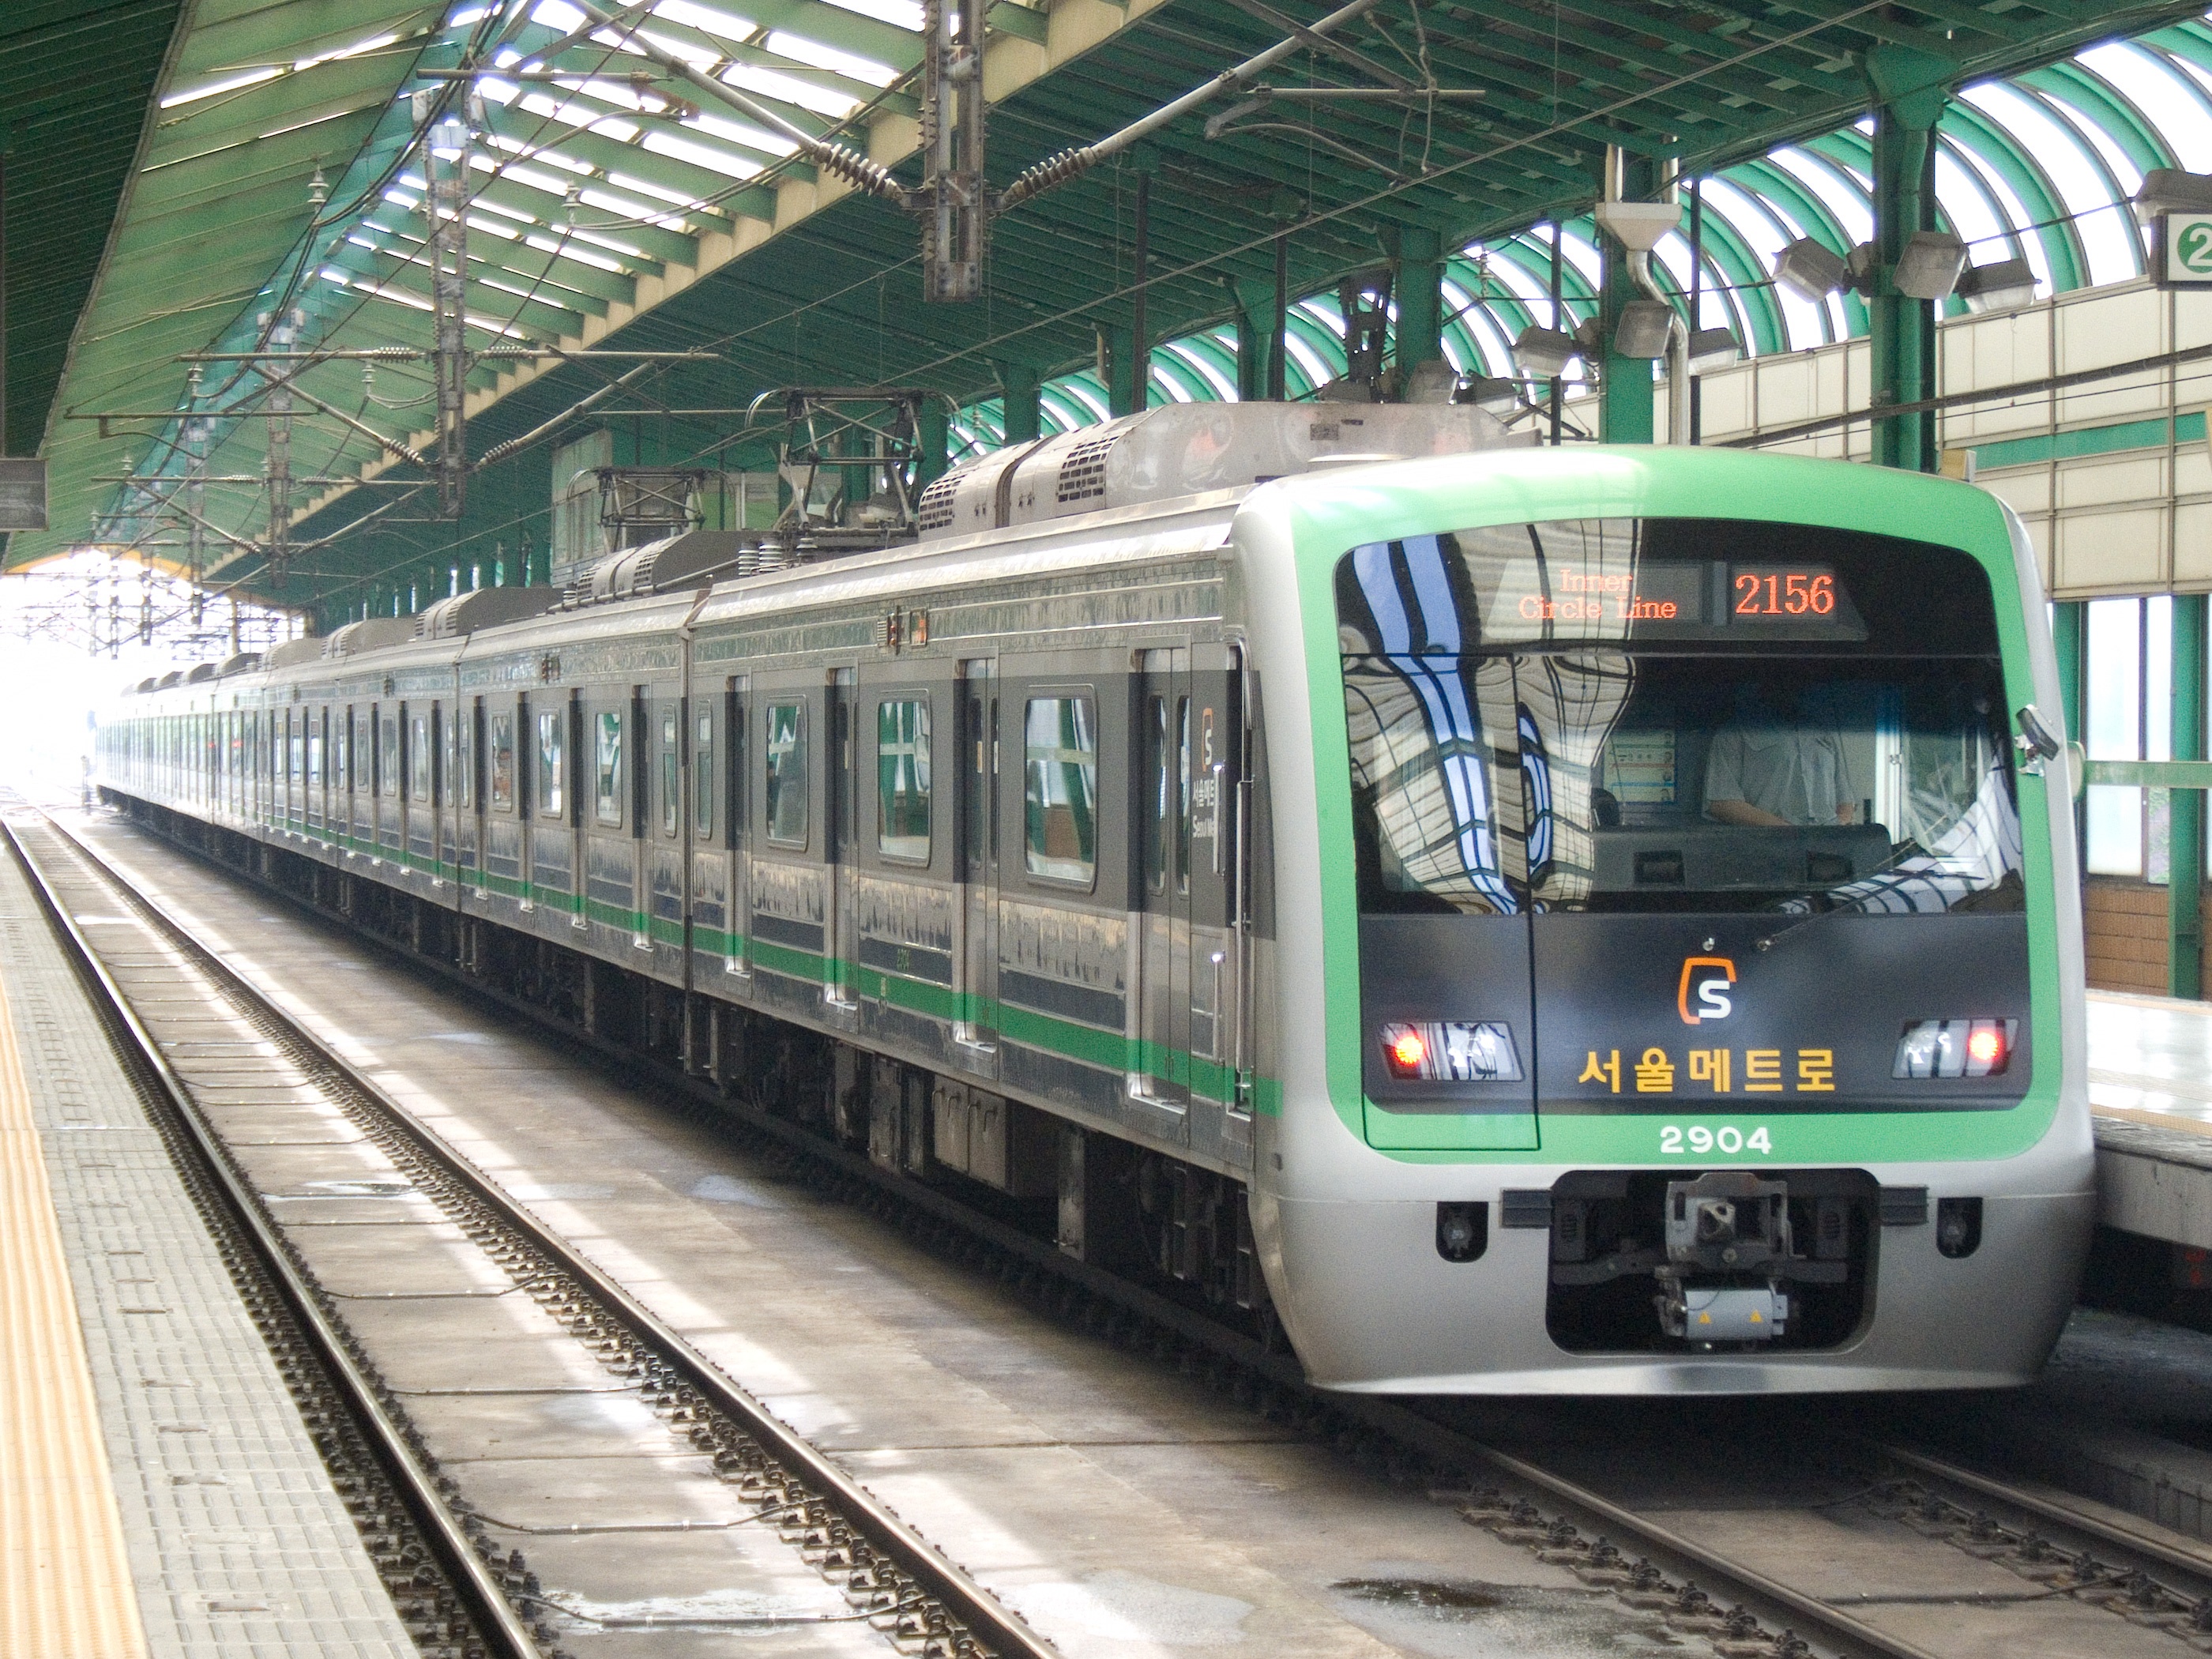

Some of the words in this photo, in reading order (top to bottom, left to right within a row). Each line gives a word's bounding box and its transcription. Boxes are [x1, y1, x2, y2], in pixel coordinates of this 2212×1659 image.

[2188, 227, 2212, 267] 2
[1559, 569, 1634, 592] Inner
[1735, 575, 1834, 615] 2156
[1518, 596, 1602, 619] Circle
[1616, 596, 1677, 619] Line
[1192, 779, 1215, 807] 서울메트
[1578, 1048, 1835, 1093] 서울메트로
[1660, 1125, 1772, 1155] 2904
